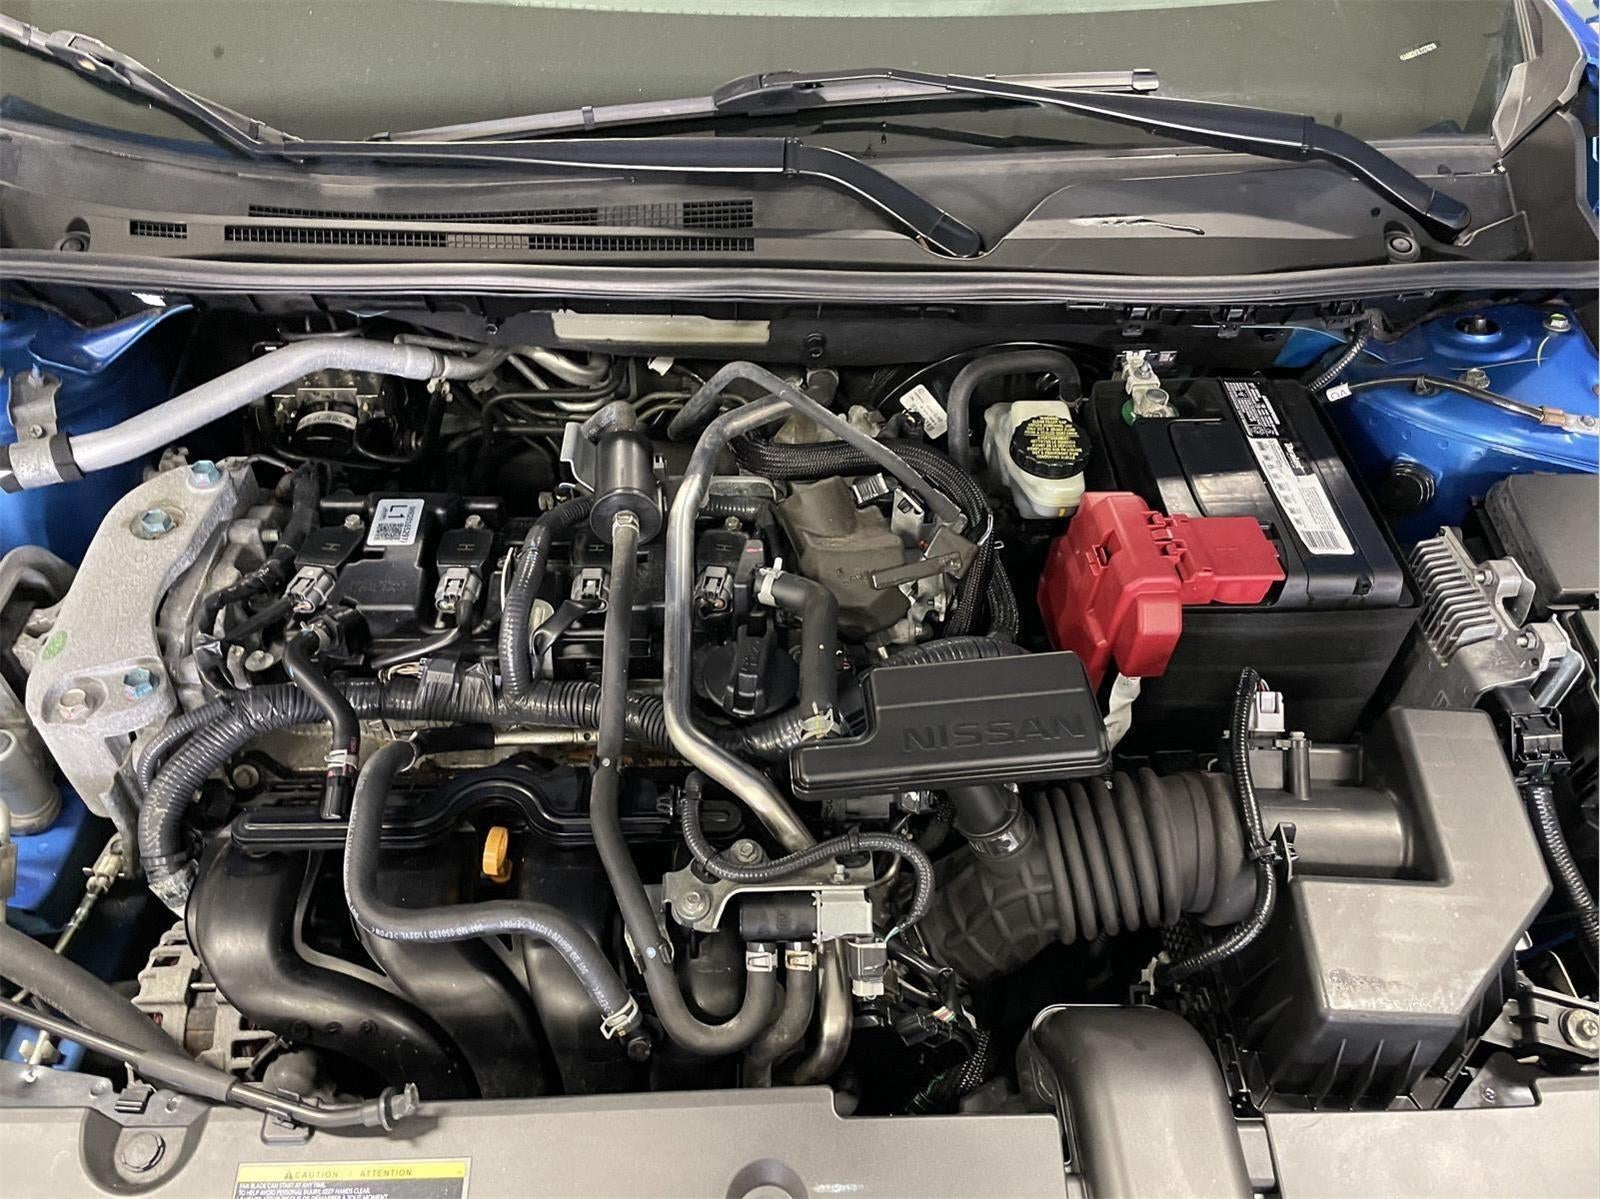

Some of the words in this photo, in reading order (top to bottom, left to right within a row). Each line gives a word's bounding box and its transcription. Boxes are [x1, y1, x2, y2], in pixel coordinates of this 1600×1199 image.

[902, 714, 1087, 752] NISSAN
[295, 1170, 339, 1179] CAUTION
[360, 1168, 413, 1177] ATTENTION
